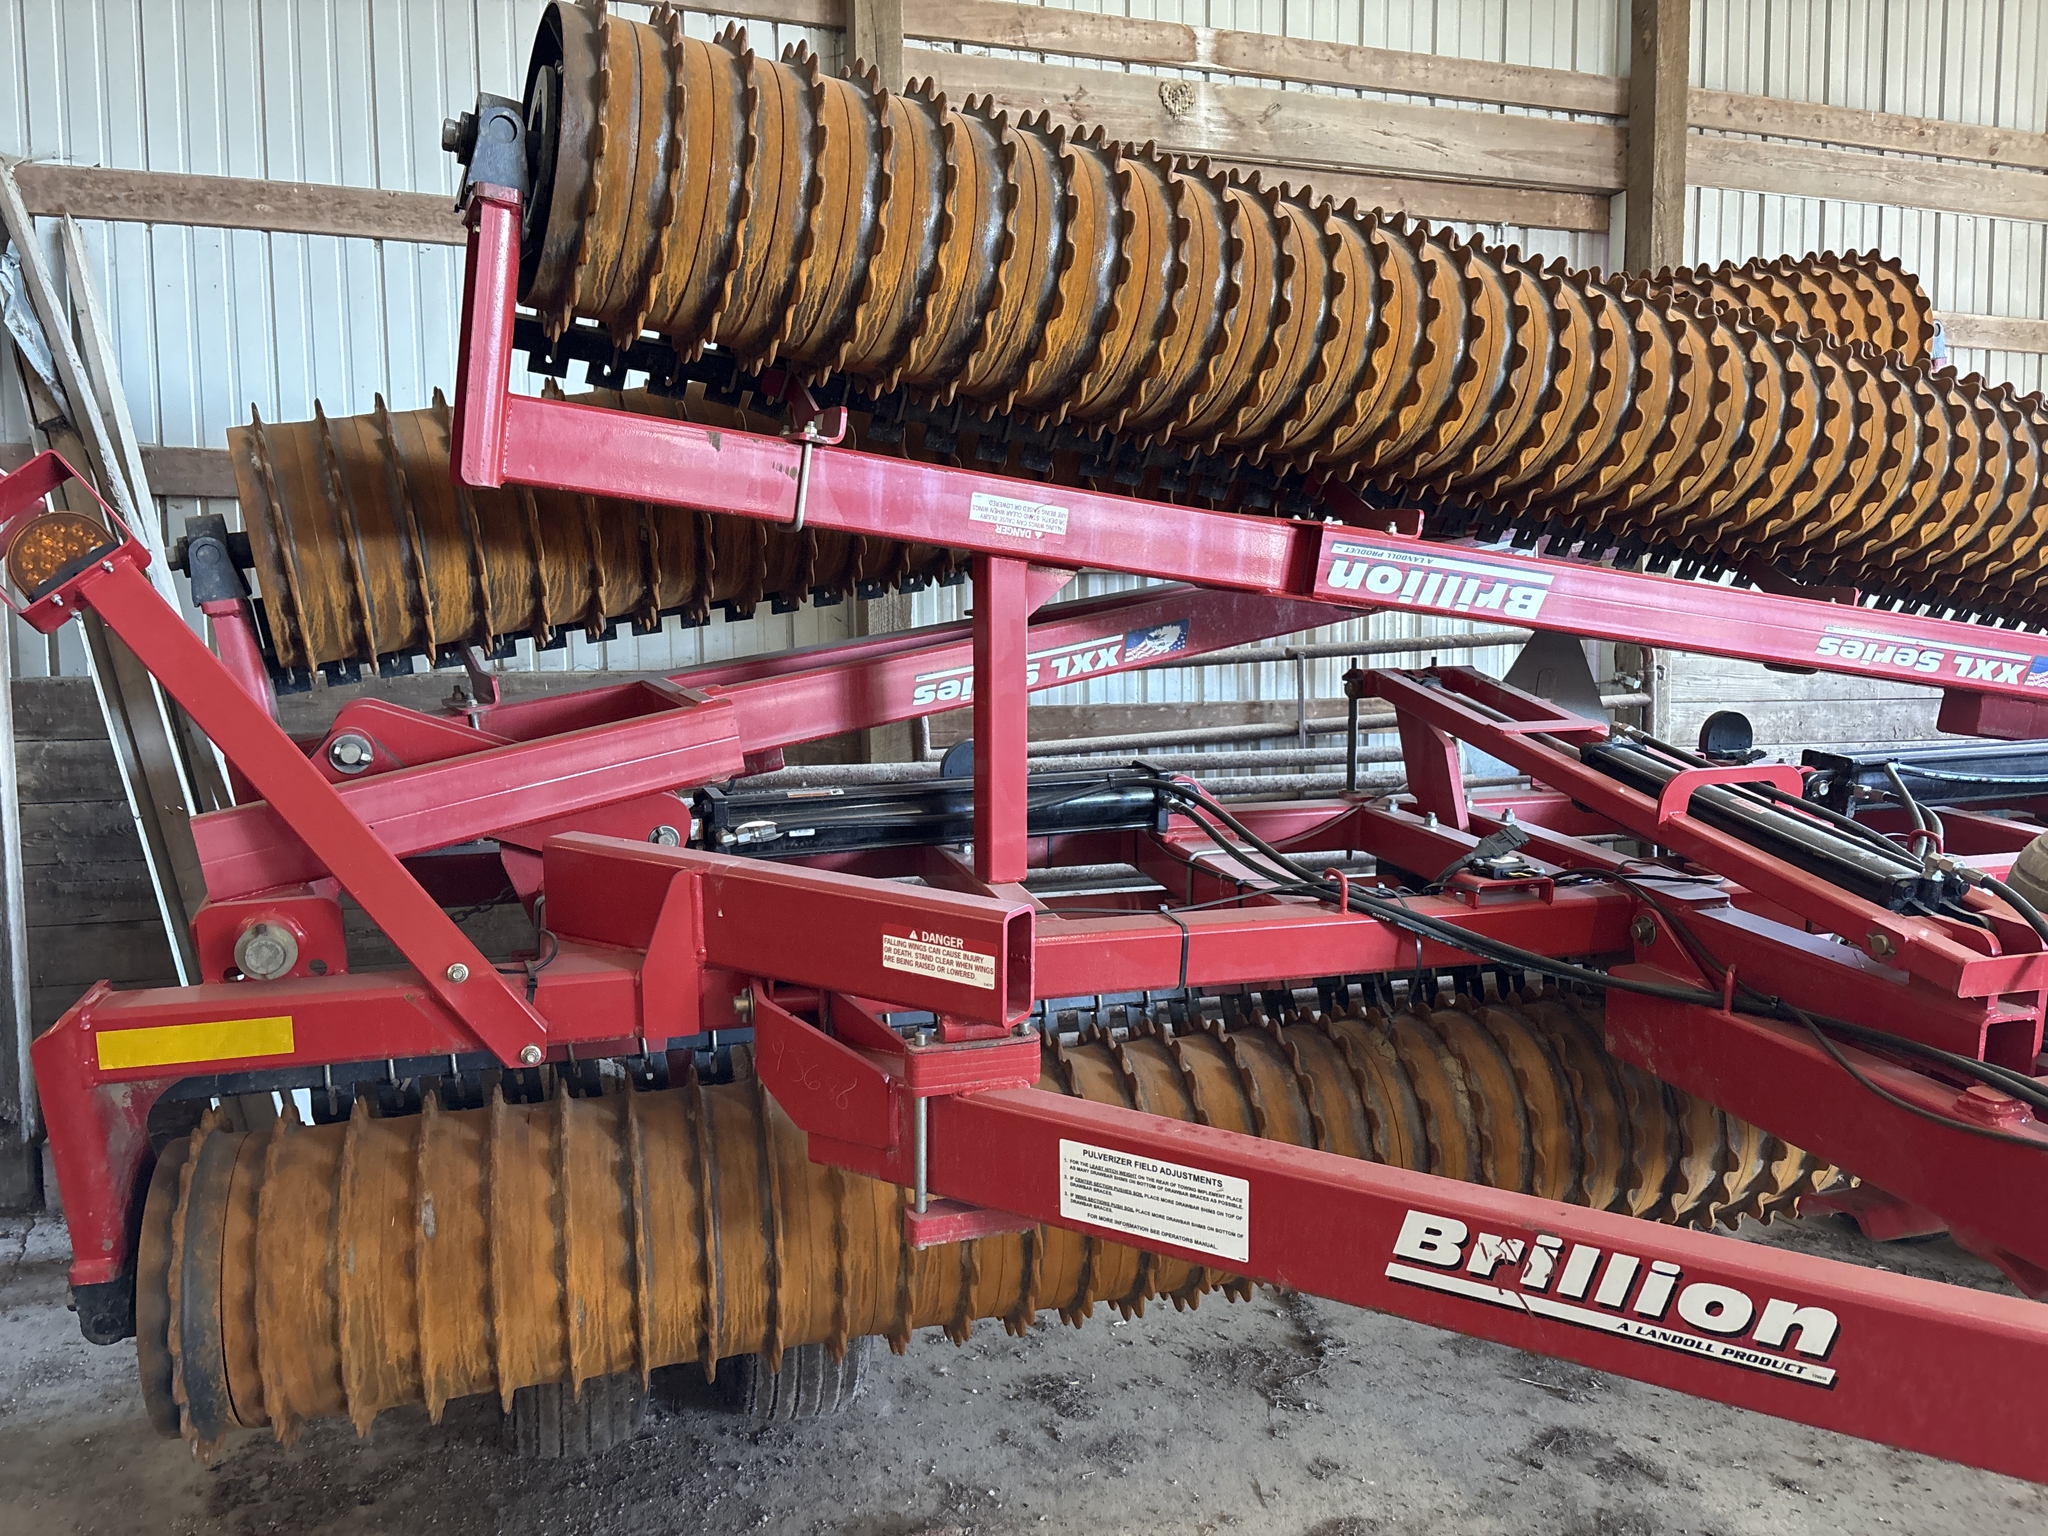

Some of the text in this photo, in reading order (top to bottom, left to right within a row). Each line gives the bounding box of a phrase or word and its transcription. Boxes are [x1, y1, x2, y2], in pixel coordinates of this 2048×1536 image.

[971, 504, 988, 512] WINGS
[979, 513, 997, 521] INJURY
[988, 507, 1005, 515] WHEN
[1005, 509, 1022, 518] CLEAR
[995, 524, 1032, 539] DANGER
[998, 516, 1015, 524] CAUSE
[1027, 521, 1044, 529] WINGS
[1344, 547, 1384, 558] PRODUCT
[1388, 553, 1424, 563] LANDOLL
[1328, 559, 1549, 620] Brillion
[1051, 645, 1121, 678] XXL
[1815, 636, 2026, 684] XXL series
[883, 937, 984, 964] FALLING WINGS CAN CAUSE INJURY
[922, 931, 964, 949] DANGER
[883, 953, 894, 962] ARE
[896, 956, 913, 966] BEING
[914, 960, 935, 971] RAISED
[936, 965, 945, 973] OR
[884, 945, 891, 953] OR
[914, 951, 933, 962] STAND
[934, 956, 954, 966] CLEAR
[955, 960, 973, 970] WHEN
[974, 964, 993, 975] WINGS
[1082, 1149, 1222, 1187] PULVERIZER FIELD ADJUSTMENTS
[1069, 1181, 1092, 1191] DRAWBAR
[1074, 1176, 1092, 1185] CENTER
[1093, 1180, 1112, 1190] SECTION
[1113, 1185, 1131, 1194] PUSHES
[1144, 1192, 1159, 1201] PLACE
[1160, 1196, 1174, 1204] MORE
[1175, 1200, 1199, 1210] DRAWBAR
[1200, 1206, 1215, 1214] SHIMS
[1090, 1169, 1112, 1179] DRAWBAR
[1136, 1180, 1156, 1189] BOTTOM
[1164, 1187, 1188, 1196] DRAWBAR
[1189, 1192, 1209, 1201] BRACES
[1104, 1166, 1118, 1174] HITCH
[1119, 1170, 1137, 1178] WEIGHT
[1156, 1178, 1168, 1186] REAR
[1177, 1183, 1196, 1192] TOWING
[1197, 1188, 1225, 1199] IMPLEMENT
[1226, 1195, 1242, 1203] PLACE
[1070, 1198, 1092, 1207] DRAWBAR
[1098, 1215, 1113, 1223] MORE
[1113, 1219, 1148, 1232] INFORMATION
[1149, 1227, 1160, 1235] SEE
[1160, 1230, 1193, 1243] OPERATORS
[1135, 1207, 1150, 1216] PLACE
[1151, 1211, 1165, 1219] MORE
[1166, 1215, 1190, 1225] DRAWBAR
[1215, 1227, 1235, 1236] BOTTOM
[1392, 1208, 1839, 1357] Brillion
[1617, 1322, 1807, 1375] A LANDOLL PRODUCT
